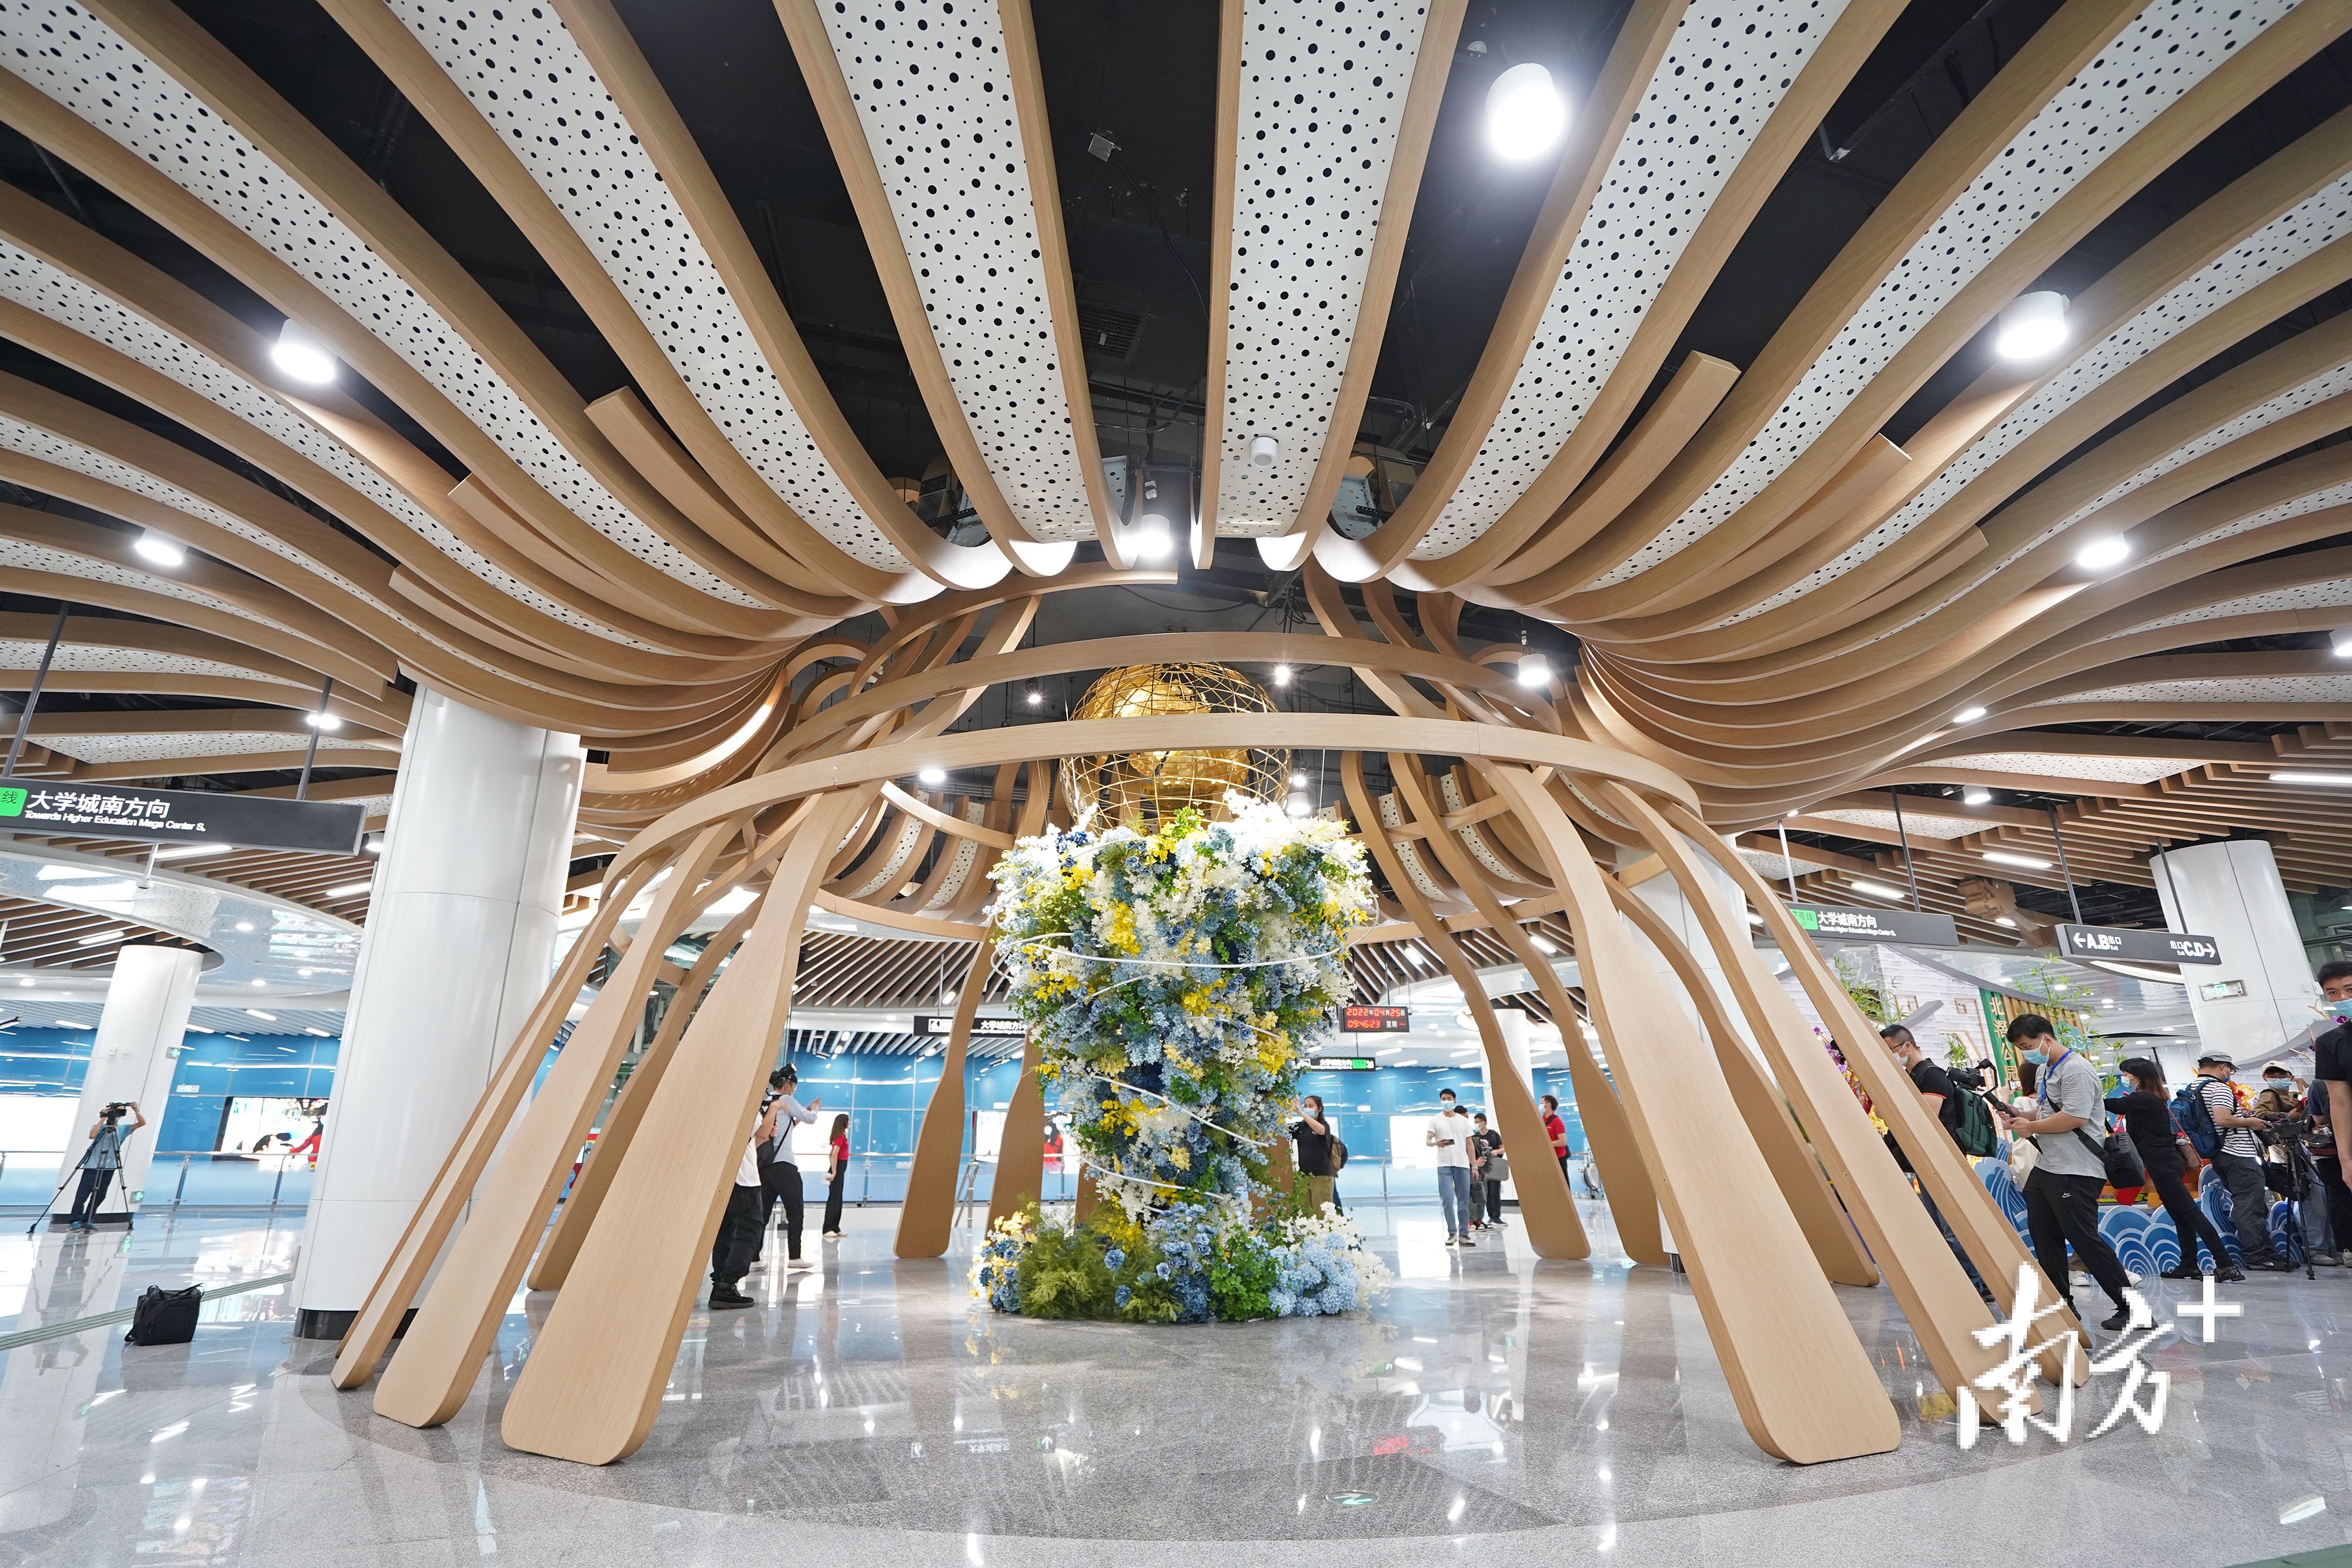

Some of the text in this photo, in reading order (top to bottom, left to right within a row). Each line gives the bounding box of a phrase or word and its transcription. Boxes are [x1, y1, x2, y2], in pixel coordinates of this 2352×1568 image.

[26, 790, 171, 818] 大学城南方向
[25, 810, 62, 821] Towards
[62, 813, 93, 823] Higher
[94, 815, 138, 826] Education
[138, 818, 164, 830] Mega
[165, 820, 196, 830] Center
[1818, 911, 1877, 928] 大学城南方向
[2108, 935, 2122, 945] 出口
[2170, 941, 2184, 950] 出口
[1347, 1008, 1405, 1017] 2022年04月25日
